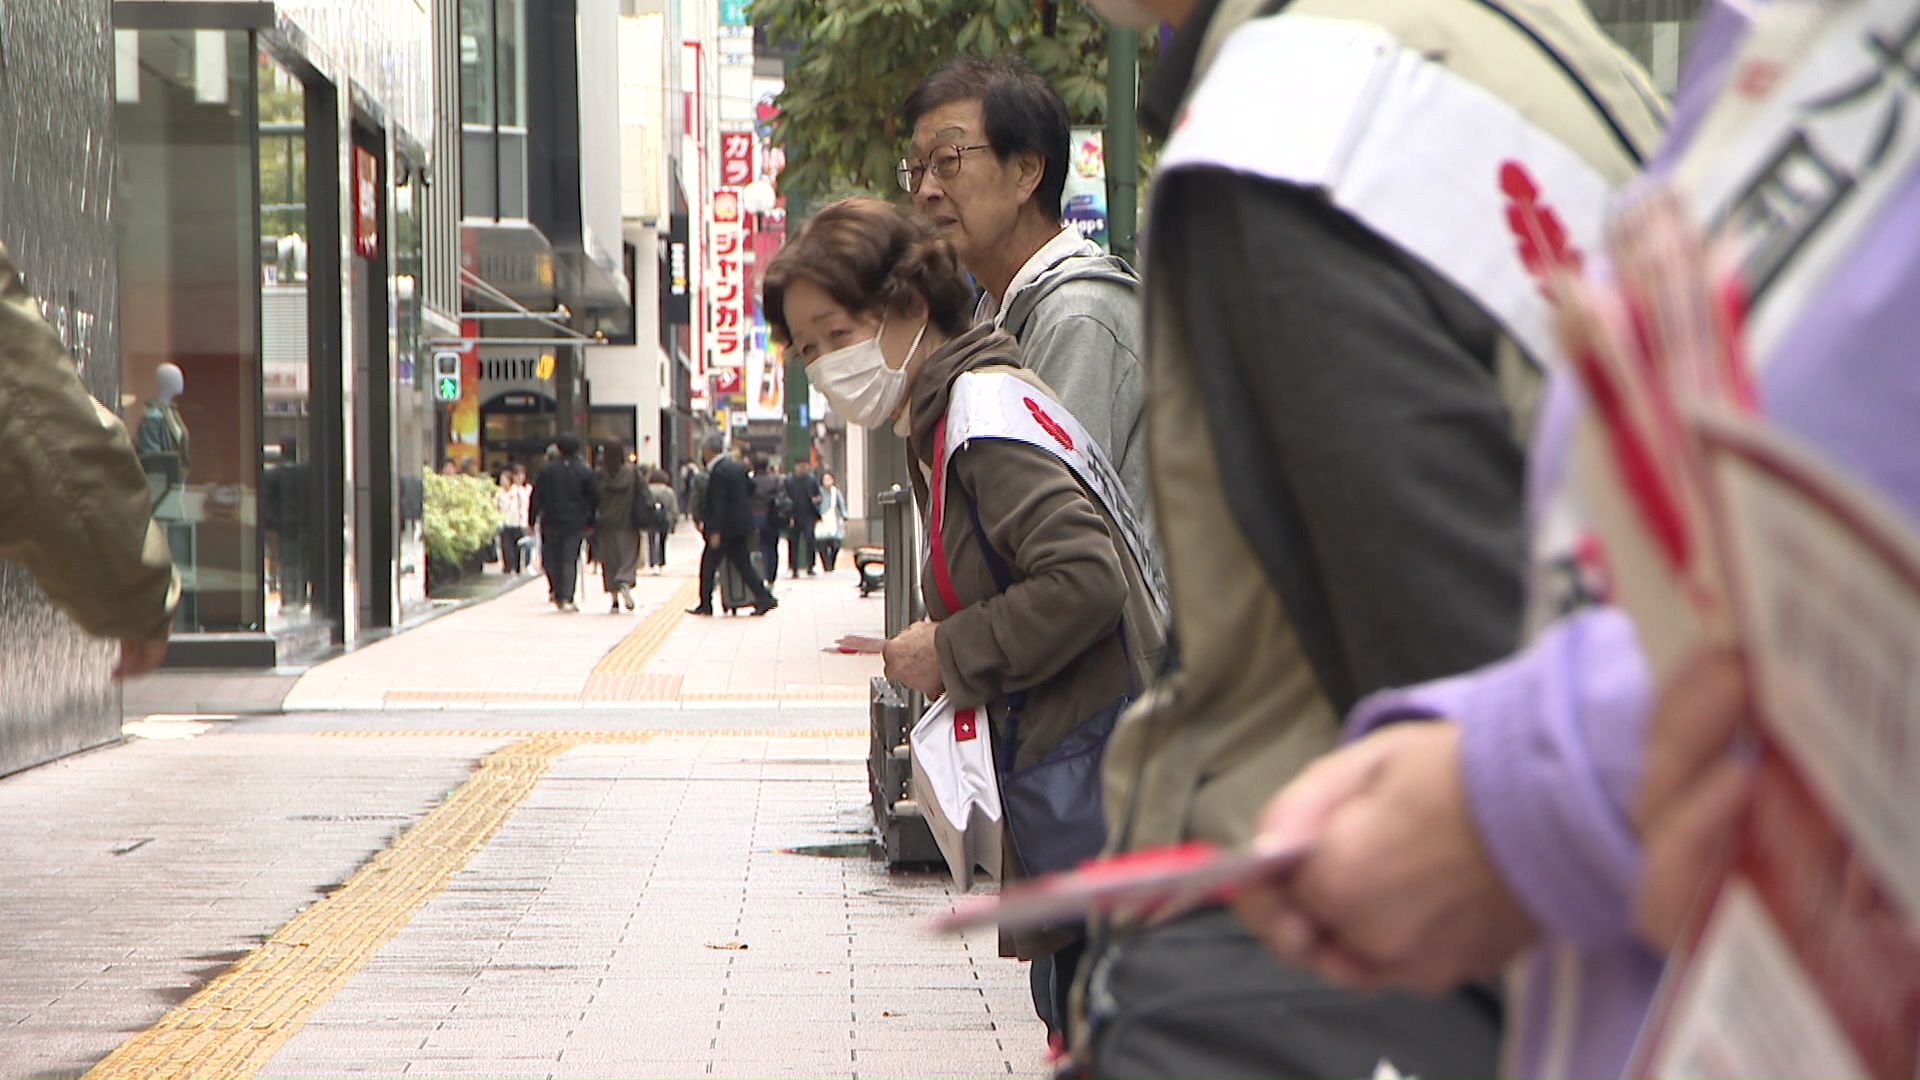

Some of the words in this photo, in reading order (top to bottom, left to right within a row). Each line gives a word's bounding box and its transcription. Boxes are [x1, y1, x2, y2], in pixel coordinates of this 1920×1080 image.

[715, 231, 739, 354] ジャンカラ
